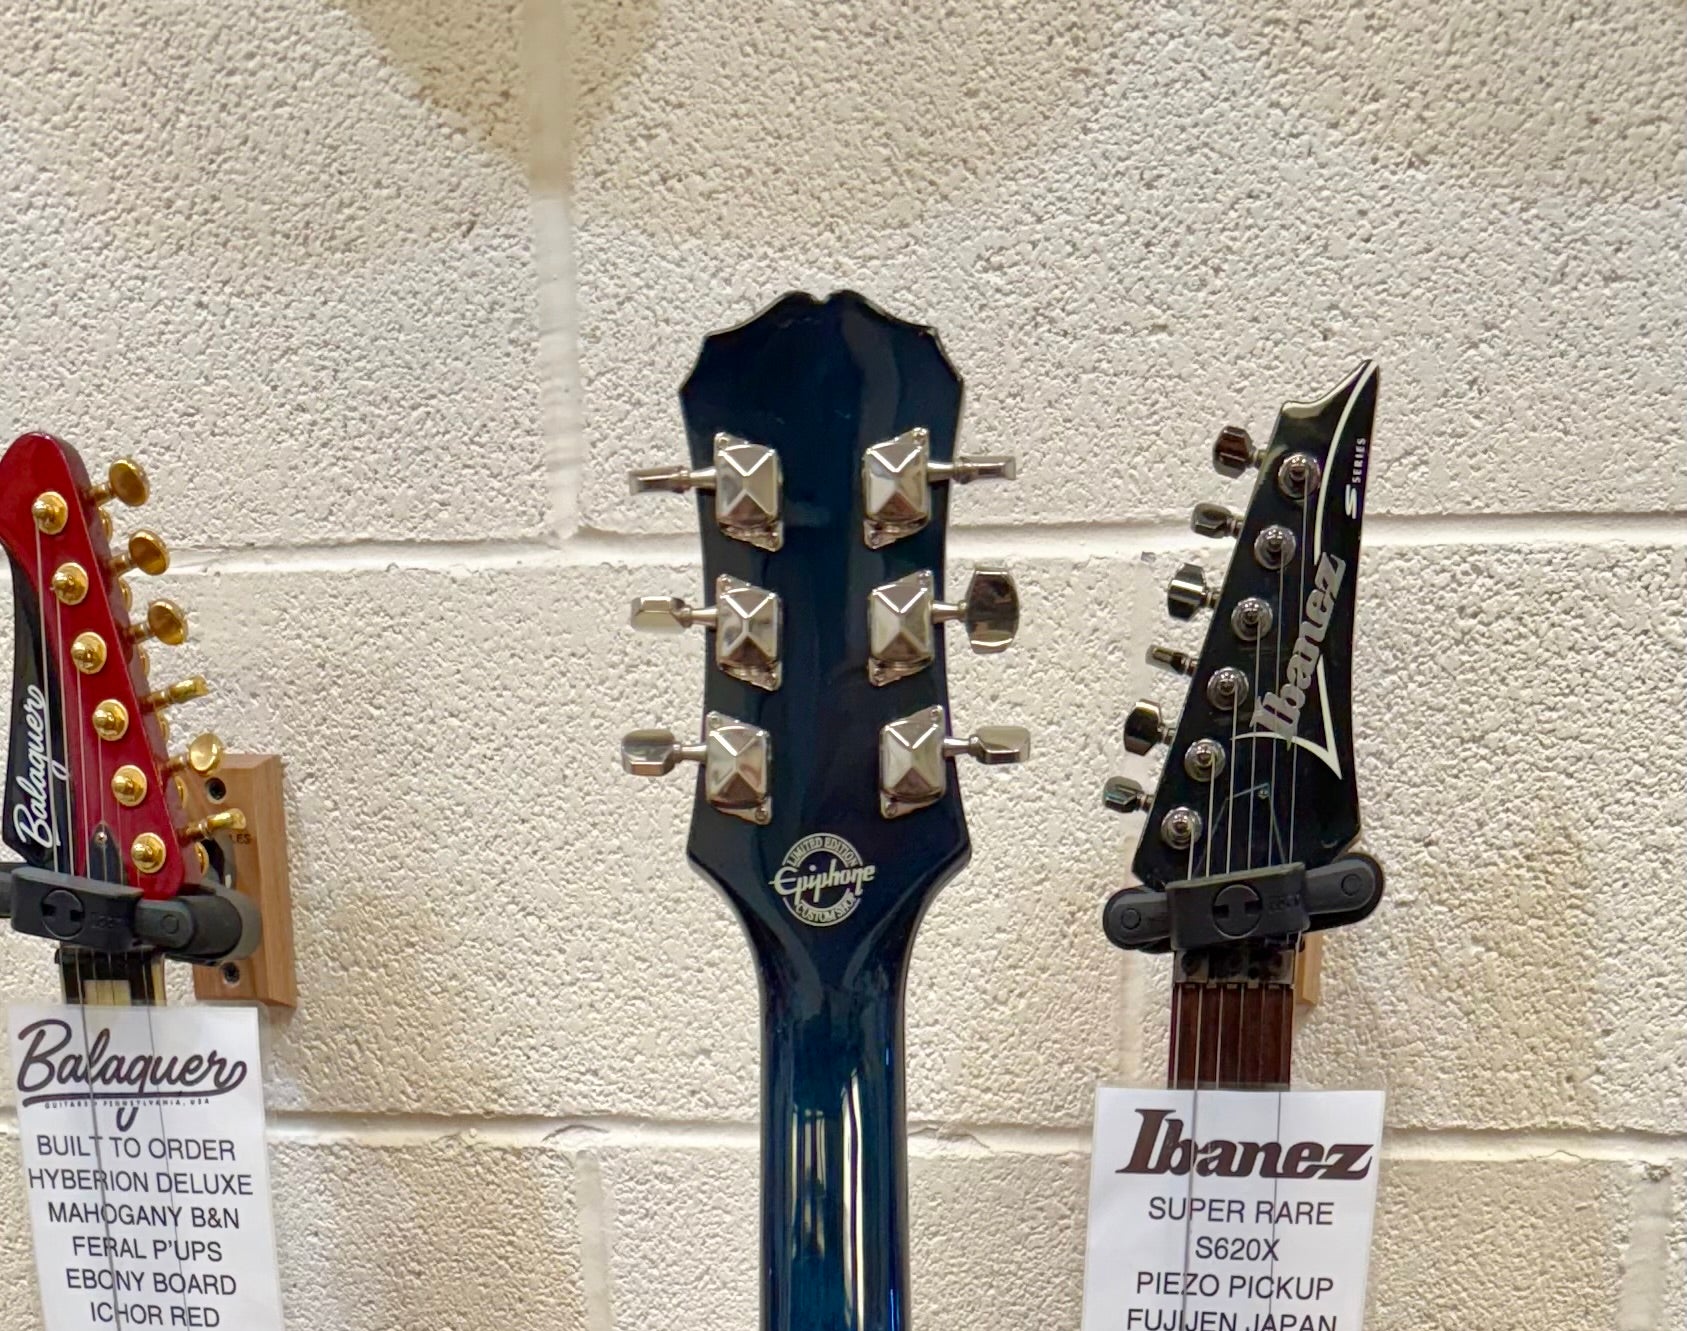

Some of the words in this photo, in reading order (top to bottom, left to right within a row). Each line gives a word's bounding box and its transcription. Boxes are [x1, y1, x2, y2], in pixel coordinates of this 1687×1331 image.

[1351, 437, 1366, 483] SERIES
[1251, 552, 1346, 749] Ibanez
[13, 684, 69, 850] Balaguer
[786, 837, 823, 867] LIMITED
[824, 837, 858, 867] EDITION
[768, 858, 876, 905] Epiphone
[17, 1019, 247, 1131] Balaguer
[44, 1101, 89, 1109] GUITARS
[37, 1135, 103, 1159] BUILT
[113, 1137, 141, 1159] TO
[148, 1138, 236, 1162] ORDER
[1115, 1108, 1374, 1180] Ibanez
[29, 1168, 149, 1193] HYBERION
[157, 1172, 254, 1196] DELUXE
[48, 1202, 182, 1227] MAHOGANY
[192, 1207, 240, 1229] B&N
[1148, 1196, 1245, 1224] SUPER
[1255, 1201, 1334, 1226] RARE
[73, 1236, 147, 1260] FERAL
[1195, 1236, 1280, 1262] S620X
[66, 1269, 145, 1291] EBONY
[153, 1272, 237, 1295] BOARD
[1137, 1272, 1219, 1297] PIEZO
[1229, 1276, 1334, 1301] PICKUP
[91, 1302, 163, 1326] ICHOR
[171, 1305, 220, 1328] RED
